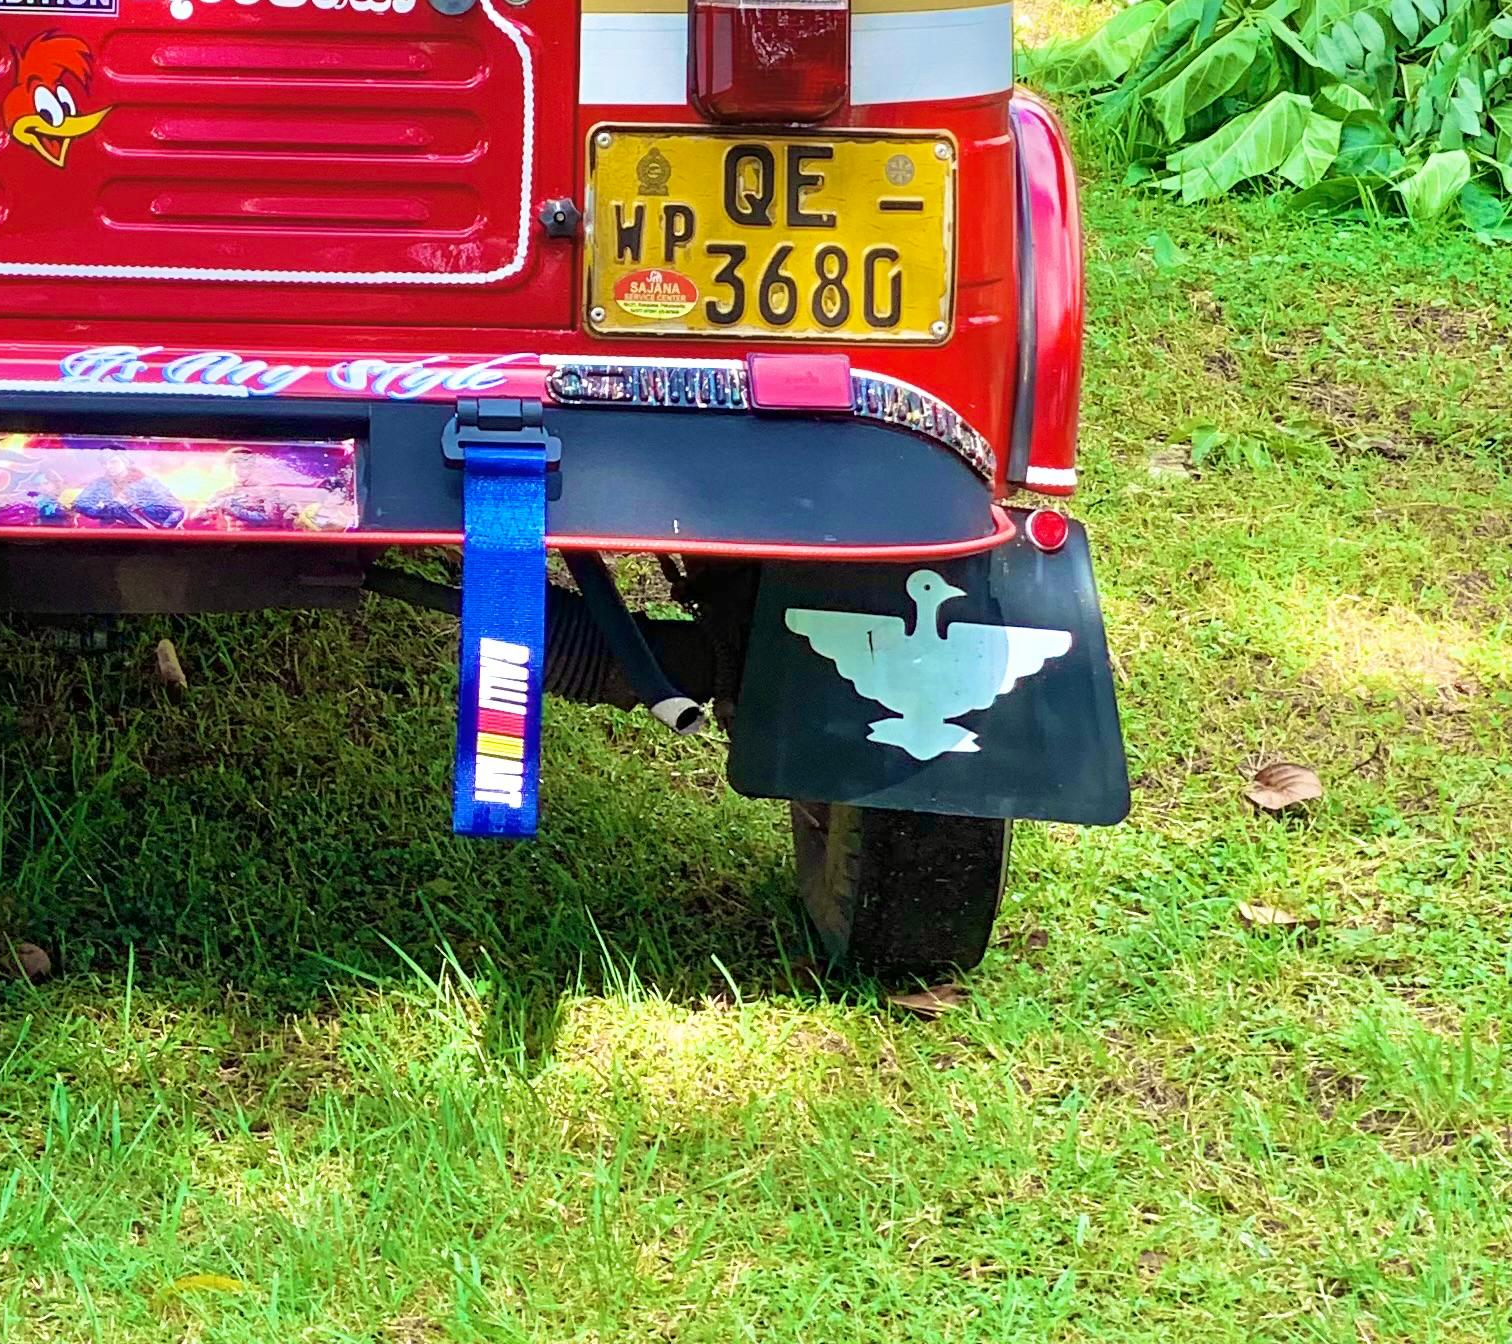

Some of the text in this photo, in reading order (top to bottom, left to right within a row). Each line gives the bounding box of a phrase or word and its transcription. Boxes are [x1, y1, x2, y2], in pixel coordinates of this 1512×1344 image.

[723, 143, 837, 228] QE
[614, 203, 695, 263] WP
[624, 293, 687, 303] SERVICE CENTER
[629, 281, 681, 295] SAJANA
[705, 244, 902, 328] 3680
[162, 351, 313, 397] My
[326, 352, 541, 400] Style
